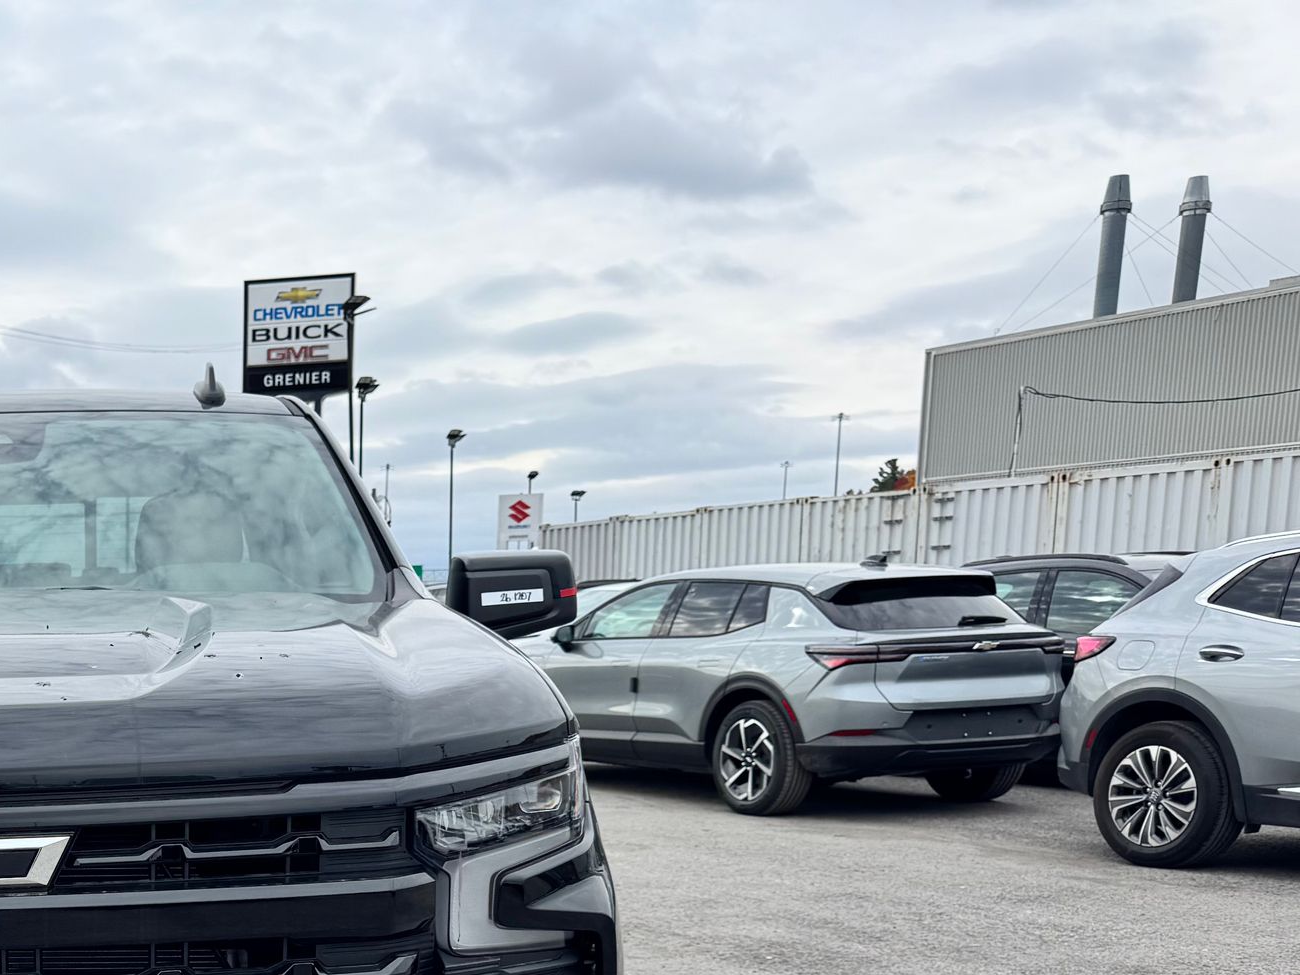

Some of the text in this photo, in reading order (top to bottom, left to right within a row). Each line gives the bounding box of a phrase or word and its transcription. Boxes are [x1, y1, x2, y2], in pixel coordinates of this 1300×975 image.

[253, 303, 344, 322] CHEVROLET
[251, 323, 344, 343] BUICK
[266, 344, 329, 363] GMC
[263, 371, 331, 388] GRENIER
